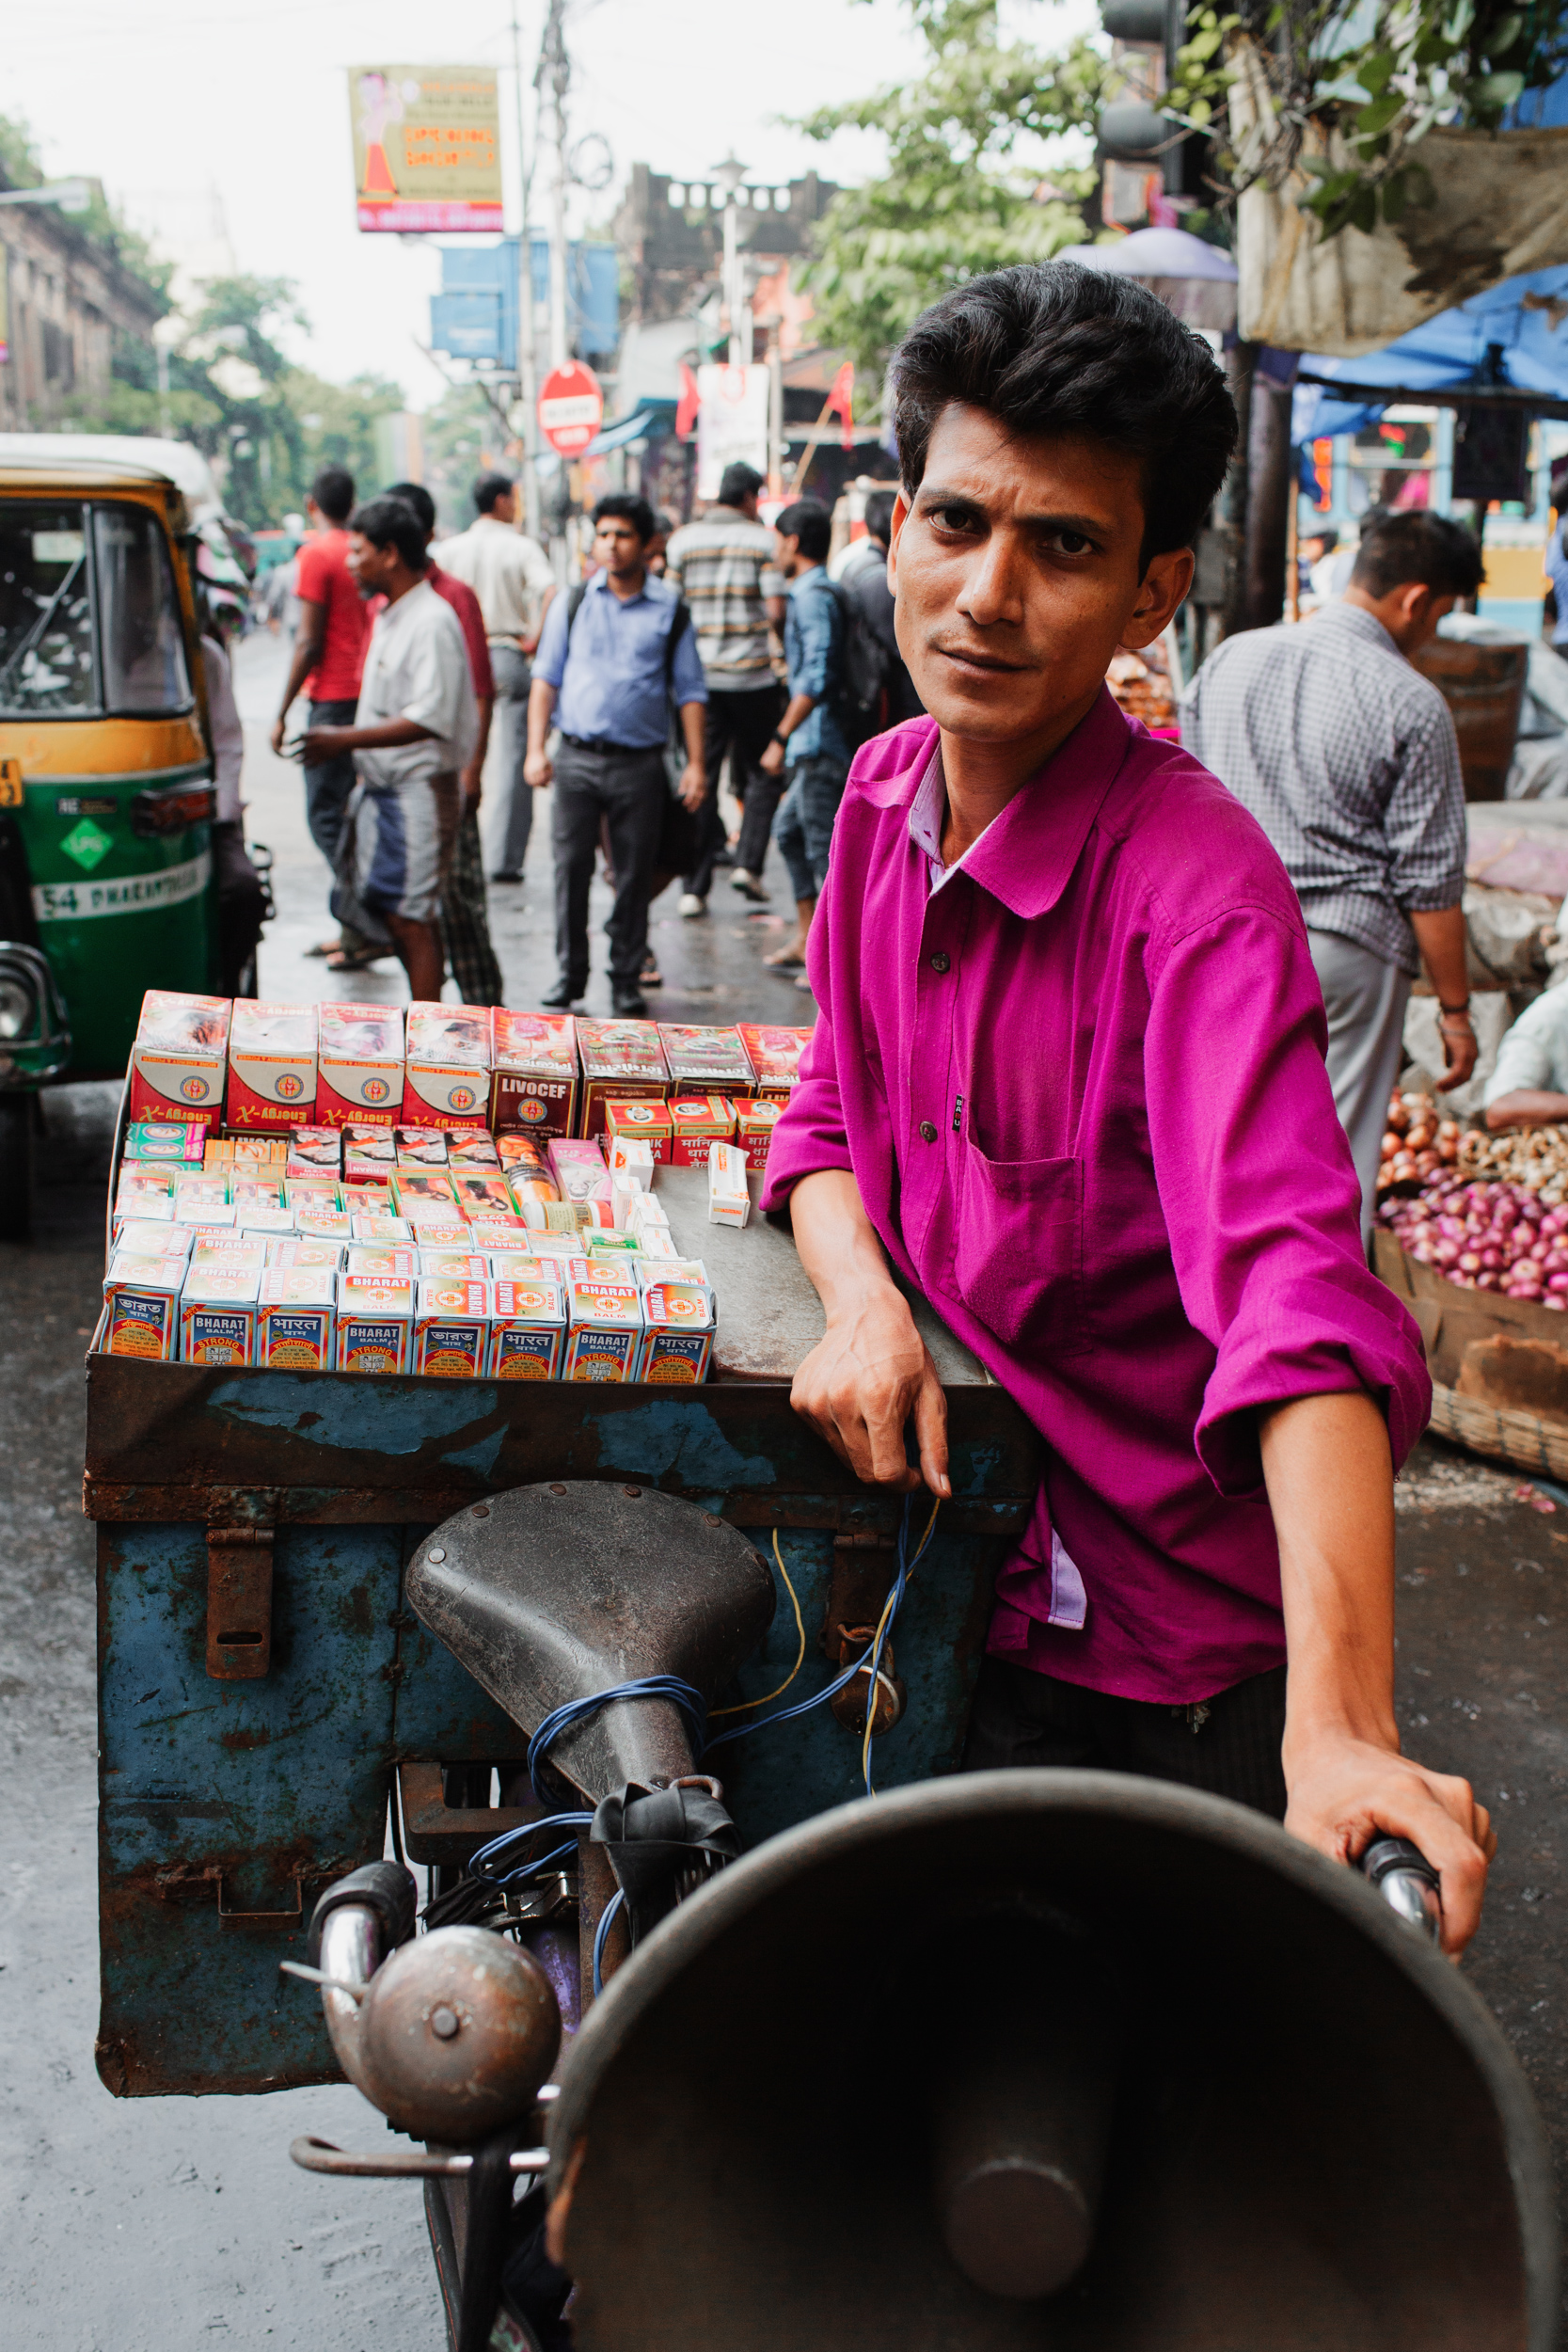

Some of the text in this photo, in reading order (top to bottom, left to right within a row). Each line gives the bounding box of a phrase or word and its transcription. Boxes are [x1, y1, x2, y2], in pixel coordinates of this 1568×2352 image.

[588, 1046, 626, 1055] HERBAL
[501, 1078, 567, 1099] LIVOCEF
[139, 1105, 213, 1126] Energy-X
[235, 1105, 308, 1123] Energy-X
[322, 1109, 393, 1126] Energy-X
[305, 1211, 343, 1220] BHARAT
[205, 1239, 260, 1249] BHARAT
[483, 1240, 522, 1248] BHARAT
[198, 1267, 254, 1279] BHARAT
[267, 1270, 285, 1298] BHARAT
[353, 1278, 408, 1287] BHARAT
[105, 1285, 118, 1298] NEW
[581, 1284, 634, 1297] BHARAT
[468, 1284, 483, 1315] BHARAT
[499, 1281, 515, 1313] BHARAT
[650, 1285, 667, 1321] BHARAT
[119, 1298, 163, 1313] ভারত
[183, 1305, 197, 1316] NEW
[260, 1305, 273, 1318] NEW
[697, 1298, 706, 1318] BALM
[129, 1310, 150, 1319] বাম
[196, 1317, 245, 1329] BHARAT
[273, 1318, 319, 1330] भारत
[339, 1316, 351, 1327] NEW
[418, 1318, 431, 1330] NEW
[493, 1322, 506, 1333] NEW
[350, 1327, 398, 1338] BHARAT
[570, 1323, 583, 1333] NEW
[647, 1327, 660, 1338] NEW
[430, 1331, 475, 1341] ভারত
[505, 1334, 550, 1346] भारत
[580, 1334, 627, 1346] BHARAT
[198, 1338, 240, 1349] STRONG
[658, 1338, 702, 1350] भारत
[351, 1345, 393, 1357] STRONG
[579, 1353, 620, 1364] STRONG
